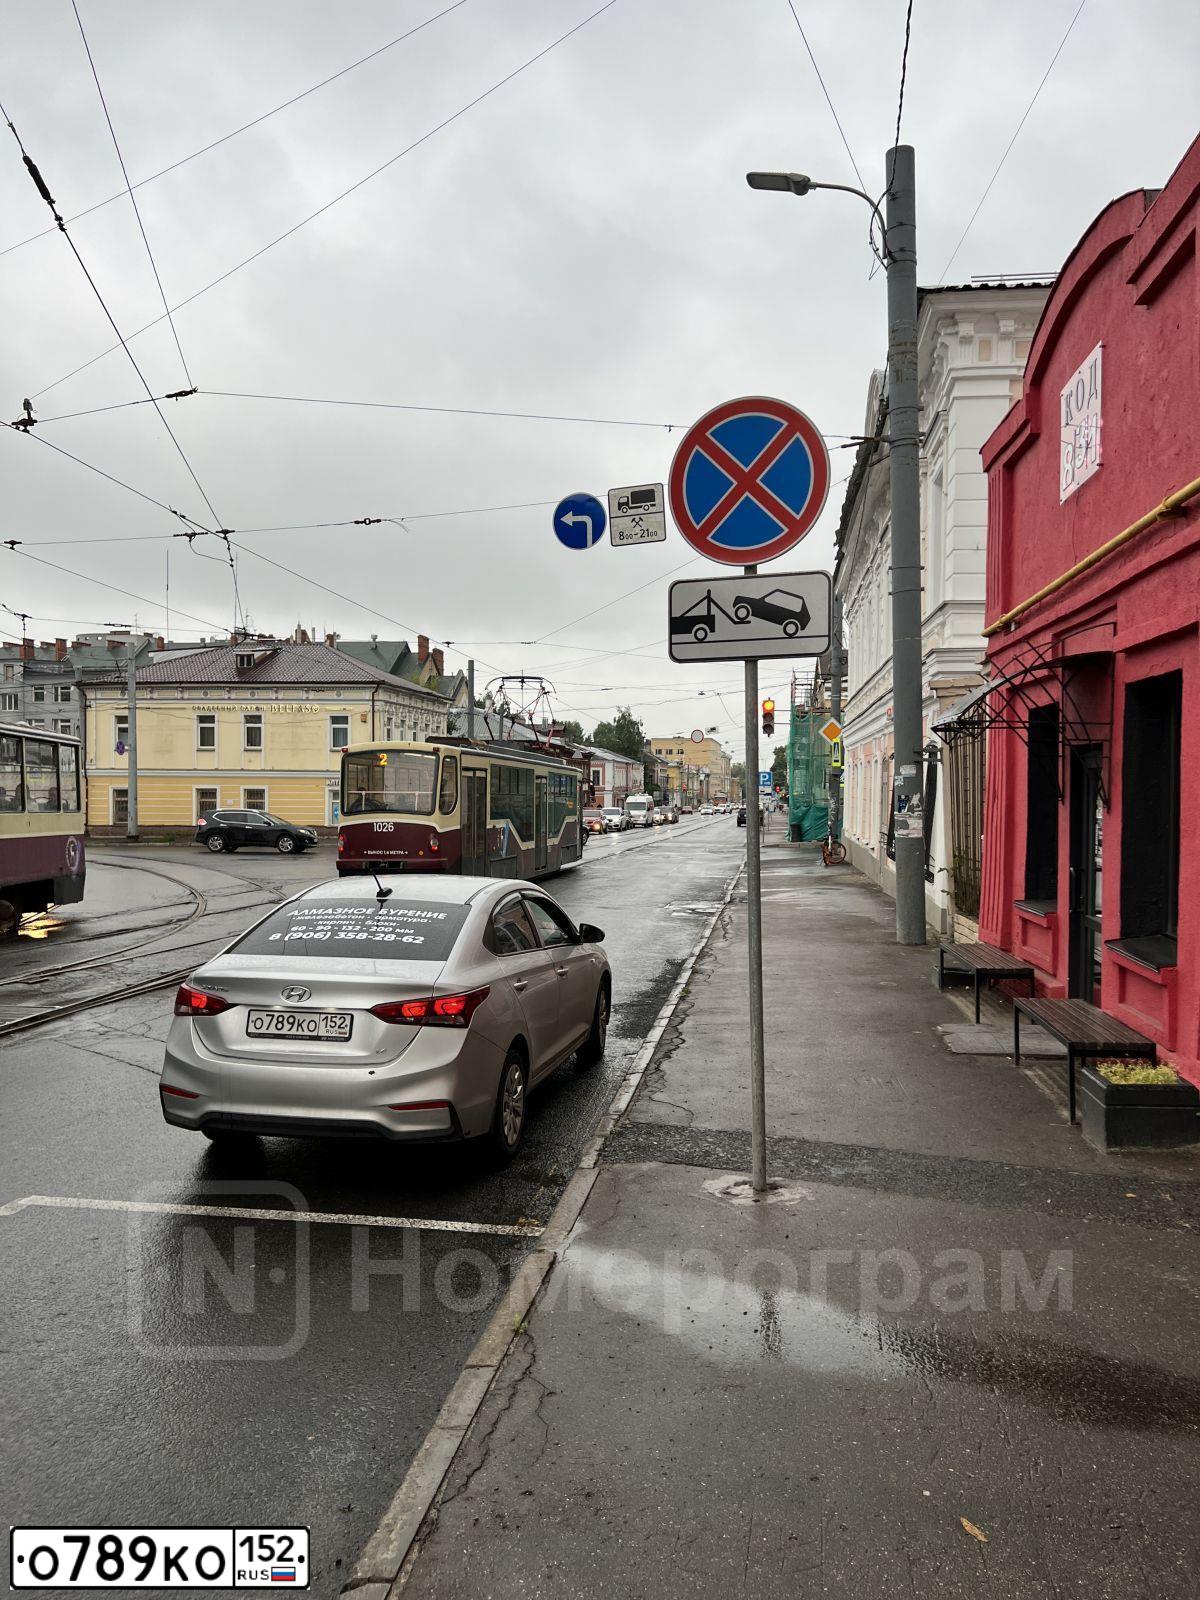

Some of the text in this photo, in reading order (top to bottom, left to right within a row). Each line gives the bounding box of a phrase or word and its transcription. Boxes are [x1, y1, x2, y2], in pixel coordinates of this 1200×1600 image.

[1065, 358, 1098, 425] КОД
[379, 754, 388, 766] 2
[373, 822, 395, 832] 1026
[286, 907, 448, 920] АЛМАЗНОЕ БУРЕНИЕ
[268, 931, 425, 944] 8 (906) 358-28-62
[253, 1013, 346, 1033] О789КО 152
